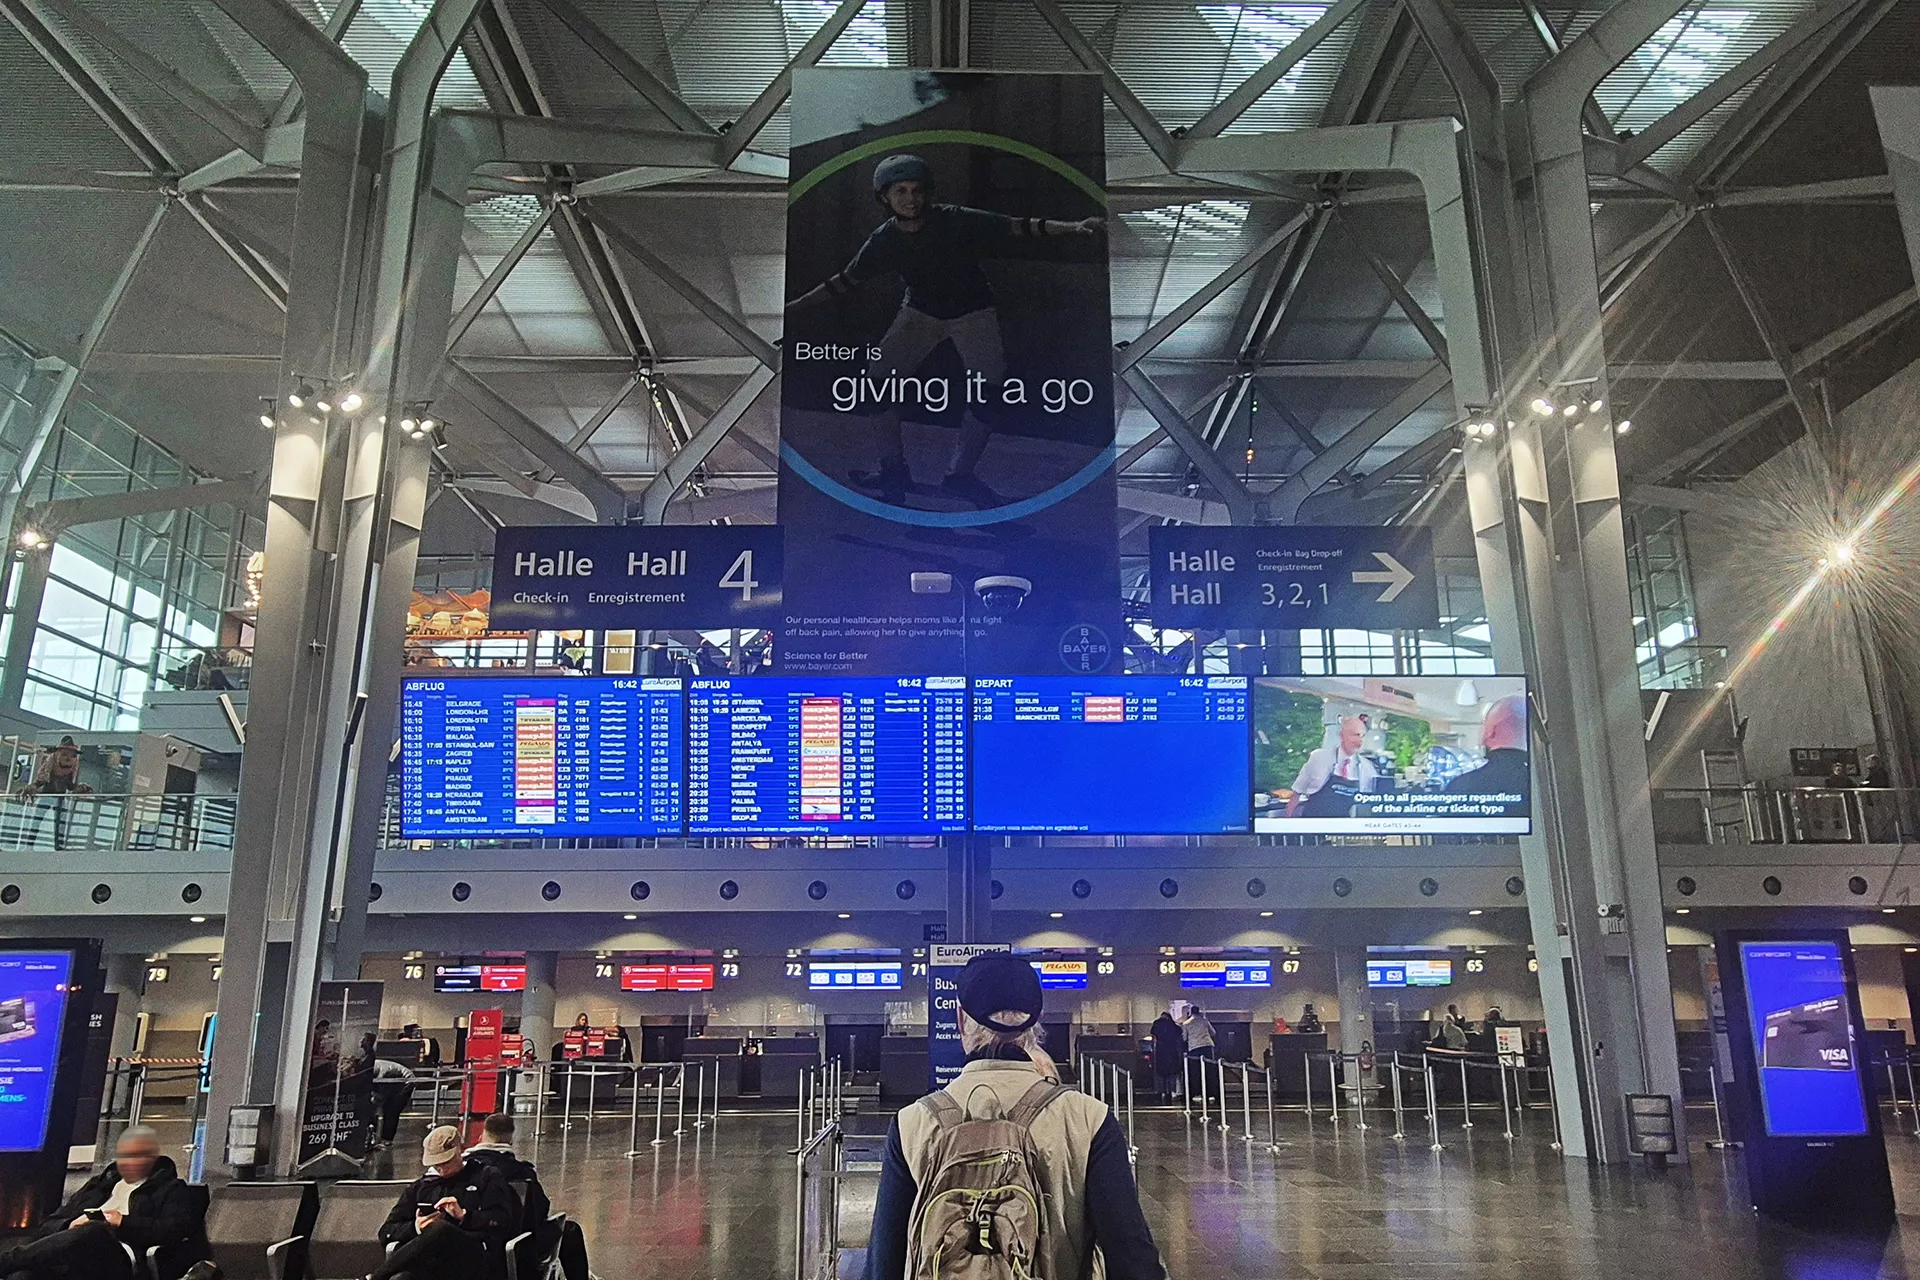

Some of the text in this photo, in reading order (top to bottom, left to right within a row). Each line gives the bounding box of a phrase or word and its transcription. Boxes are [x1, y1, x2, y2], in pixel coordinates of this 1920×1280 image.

[795, 342, 882, 360] Better is
[832, 368, 1094, 413] giving it a go
[1256, 549, 1343, 559] Check-in Bag Drop-off
[1169, 550, 1236, 572] Halle
[1258, 563, 1323, 572] Enregistrement
[514, 550, 759, 601] Halle Hall 4
[513, 592, 686, 606] Check-in Enregistrement
[1170, 582, 1221, 605] Hall
[785, 616, 801, 624] Our
[803, 616, 841, 625] personal
[842, 616, 887, 624] healthcare
[889, 616, 912, 625] helps
[983, 616, 1002, 625] fight
[785, 628, 988, 637] off back pain, allowing her to give anything go.
[1063, 644, 1106, 653] BAYER
[1080, 628, 1090, 670] BAYER
[784, 651, 868, 660] Science for Better
[784, 662, 853, 671] www.bayer.com
[405, 682, 445, 691] ABFLUG
[613, 681, 637, 689] 16:42
[691, 680, 730, 689] ABFLUG
[897, 679, 921, 687] 16:42
[975, 679, 1013, 688] DEPART
[1179, 678, 1204, 687] 16:42
[1354, 792, 1522, 804] Open to all passengers regardless
[1371, 804, 1504, 815] of the airline or ticket type
[595, 964, 612, 977] 74
[722, 963, 738, 977] 73
[786, 963, 802, 976] 72
[911, 963, 926, 976] 71
[1097, 961, 1114, 974] 69
[1159, 961, 1176, 974] 68
[1282, 960, 1299, 973] 67
[1466, 959, 1483, 972] 65
[1527, 959, 1538, 972] 6
[148, 968, 167, 981] 79
[212, 967, 223, 980] 7
[405, 966, 422, 979] 76
[934, 996, 958, 1010] Cen
[935, 1022, 957, 1031] Zugang
[952, 1032, 961, 1040] via
[1819, 1048, 1848, 1061] VISA
[310, 1113, 344, 1122] UPGRADE
[338, 1120, 360, 1128] CLASS
[308, 1133, 327, 1145] 269
